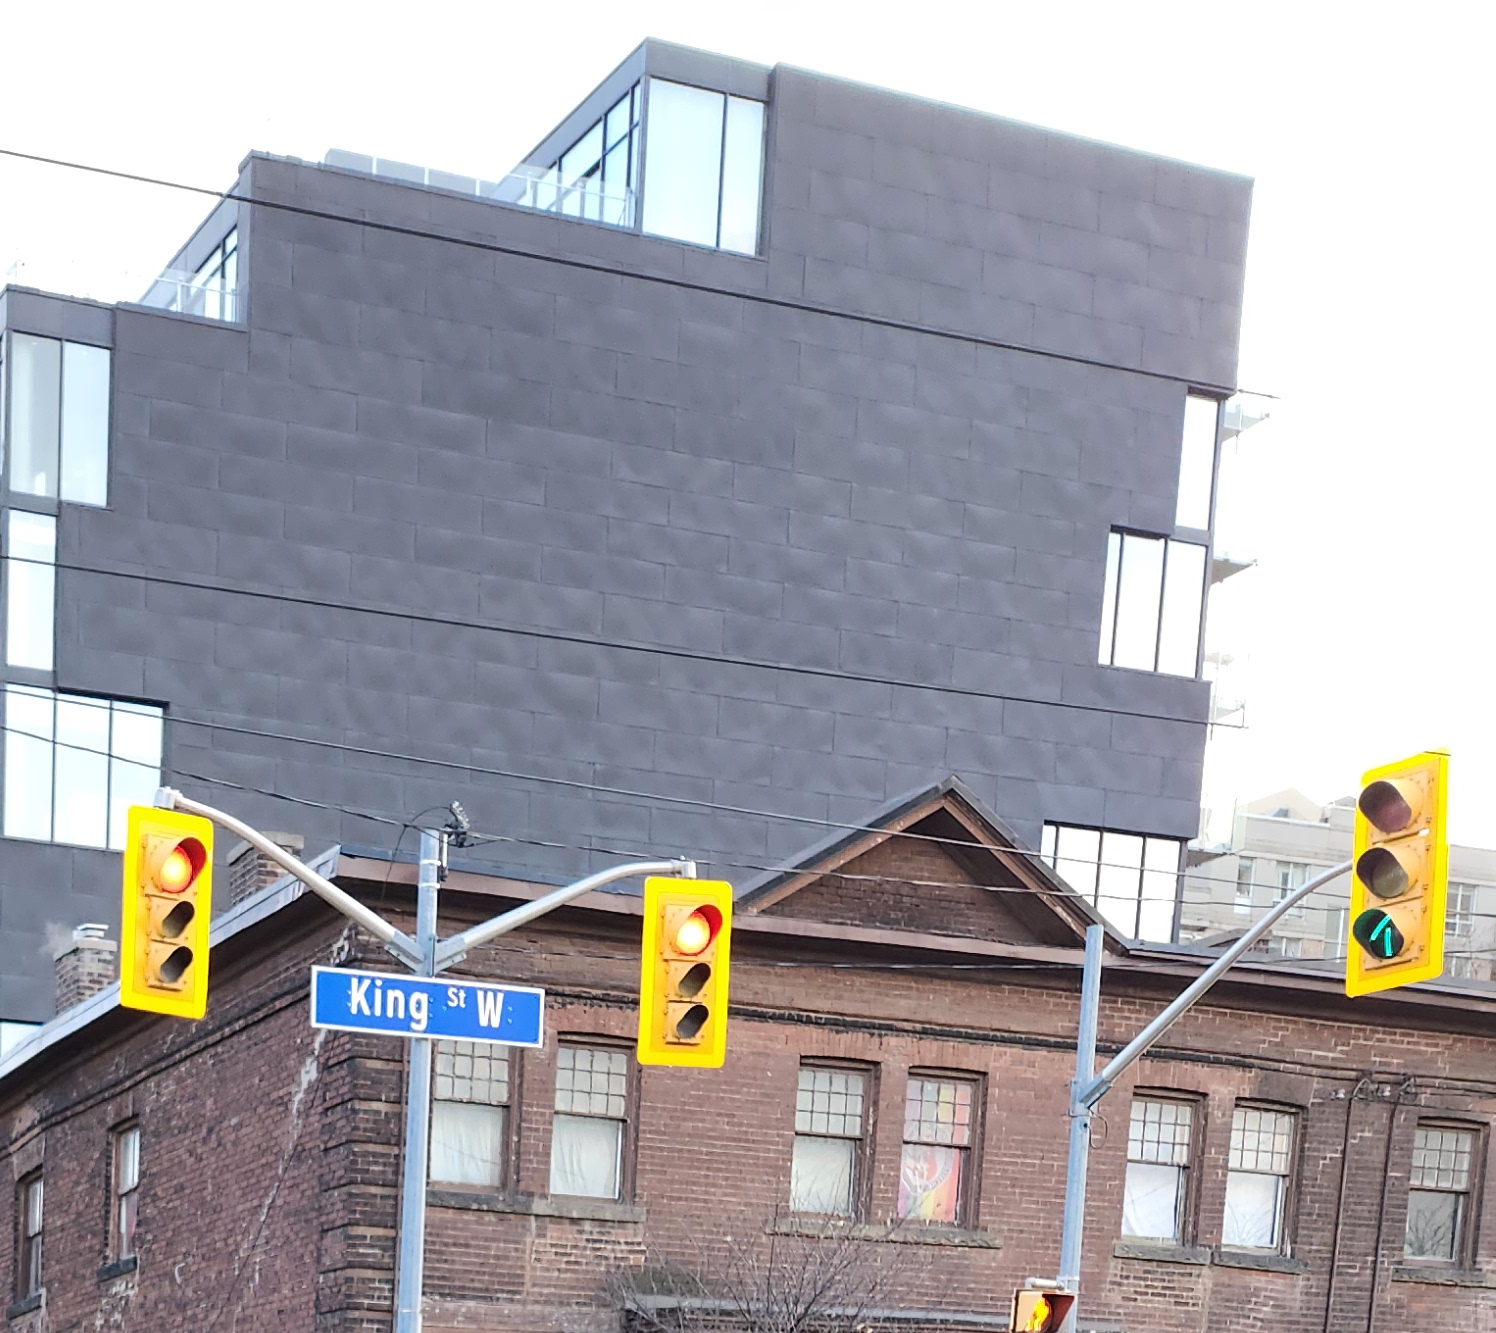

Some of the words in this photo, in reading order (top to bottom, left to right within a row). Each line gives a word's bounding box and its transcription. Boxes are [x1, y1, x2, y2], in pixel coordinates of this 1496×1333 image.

[350, 977, 429, 1031] King
[447, 988, 467, 1008] St
[476, 990, 505, 1029] W
